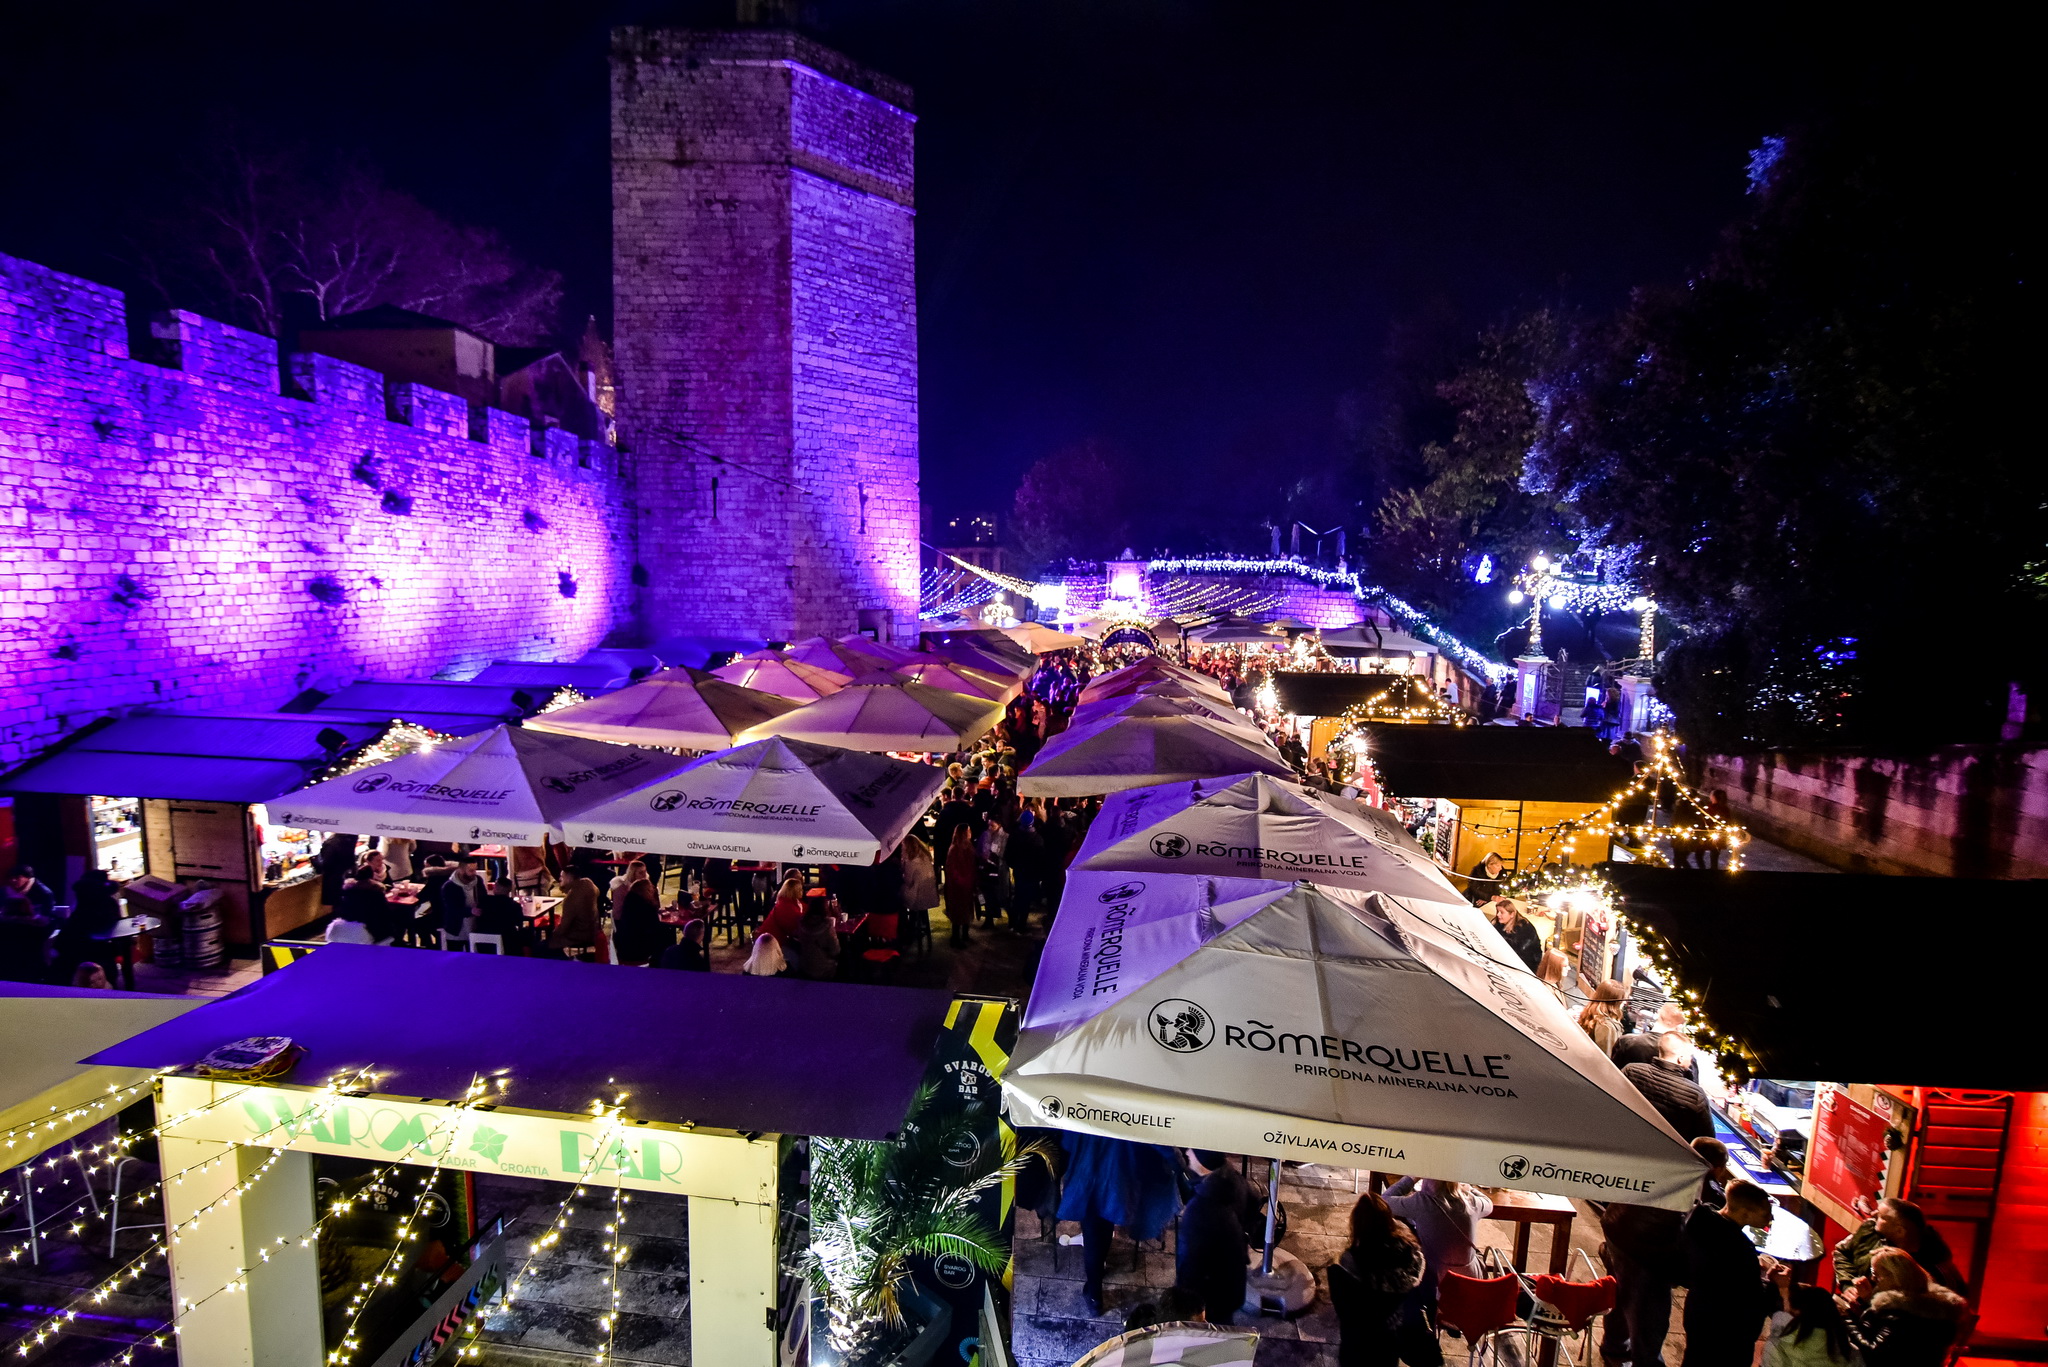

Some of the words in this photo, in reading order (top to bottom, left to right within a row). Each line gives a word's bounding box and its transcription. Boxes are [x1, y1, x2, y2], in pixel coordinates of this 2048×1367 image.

[722, 845, 751, 853] OSJETILA
[1236, 861, 1284, 871] PRIRODNA
[1285, 866, 1339, 876] MINERALNA
[944, 1060, 992, 1078] SVAROG
[1294, 1063, 1375, 1084] PRIRODNA
[1378, 1074, 1468, 1095] MINERALNA
[1469, 1084, 1519, 1099] VODA
[958, 1085, 978, 1095] BAR
[243, 1095, 449, 1157] SVAROG
[1263, 1131, 1338, 1151] OŽIVLJAVA
[1341, 1142, 1406, 1160] OSJETILA
[560, 1130, 682, 1185] BAR
[500, 1163, 550, 1177] CROATIA
[943, 1264, 967, 1273] SVAROG
